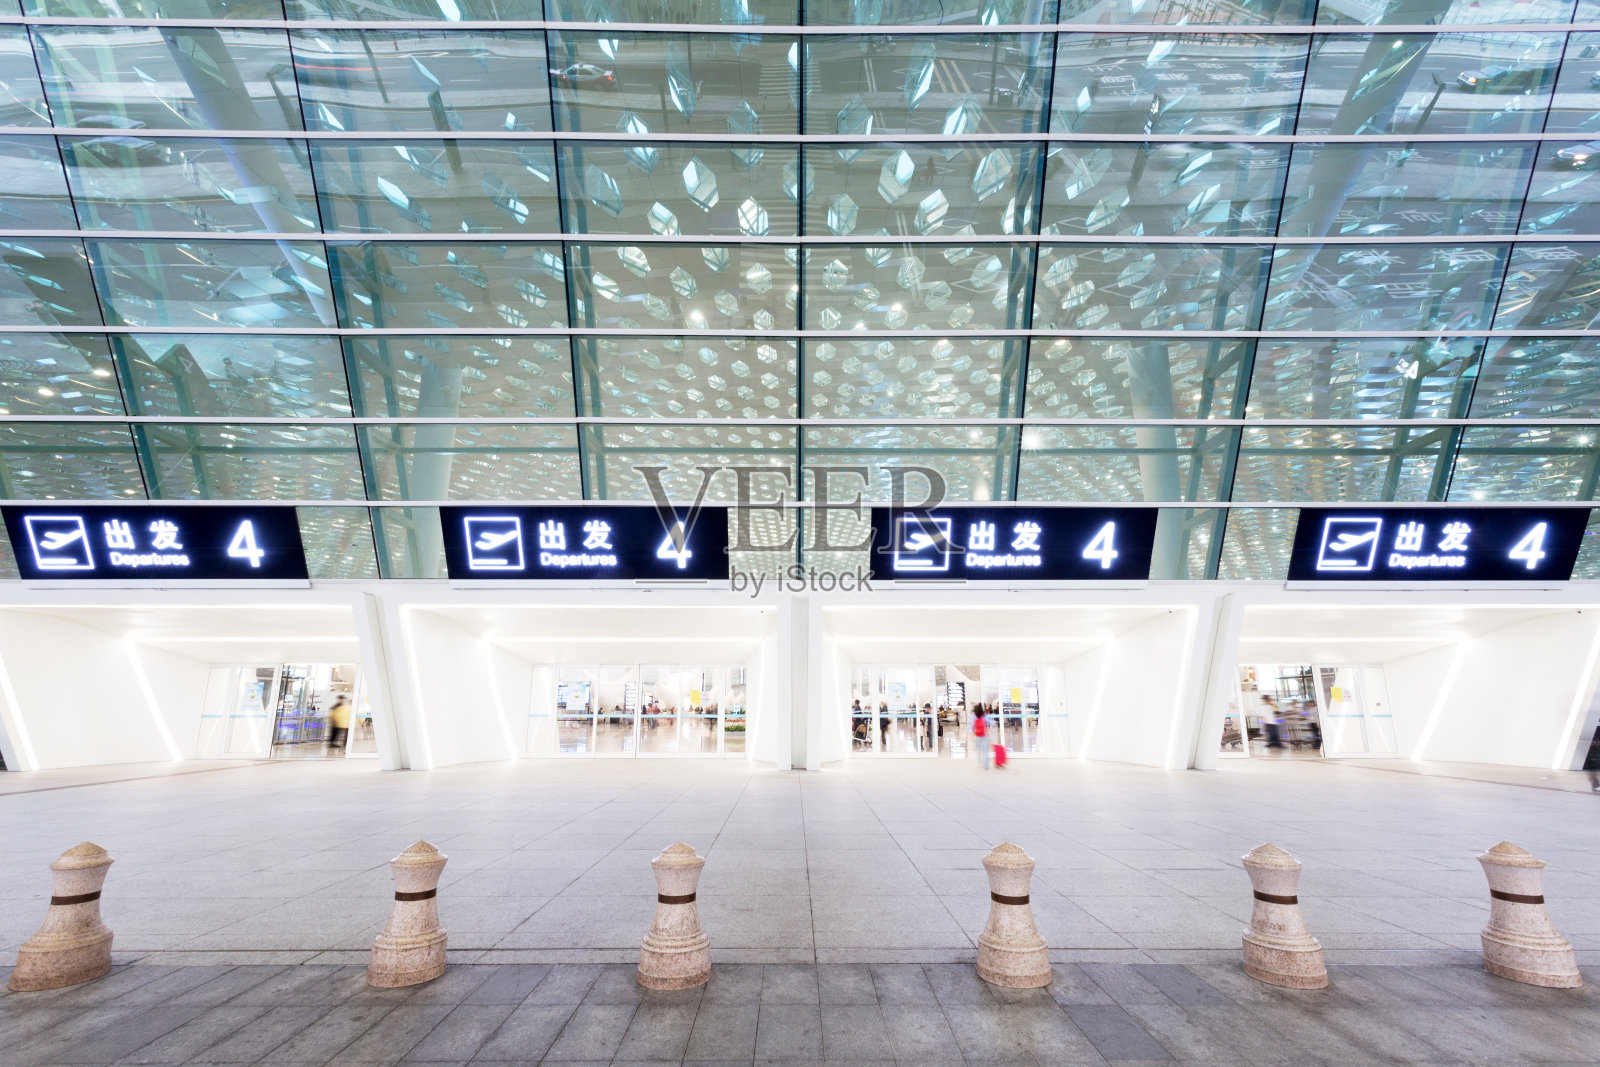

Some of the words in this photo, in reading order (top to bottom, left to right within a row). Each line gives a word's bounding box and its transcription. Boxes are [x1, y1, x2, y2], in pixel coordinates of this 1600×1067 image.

[103, 518, 184, 550] 出发
[226, 519, 266, 568] 4
[538, 519, 613, 551] 出发
[656, 519, 693, 570] 4
[967, 520, 1042, 552] 出发
[1081, 521, 1119, 570] 4
[1393, 521, 1472, 552] 出发
[1507, 521, 1548, 570] 4
[108, 551, 191, 568] Departures
[539, 552, 618, 569] Departures
[965, 552, 1042, 570] Departures
[1387, 553, 1467, 570] Departures
